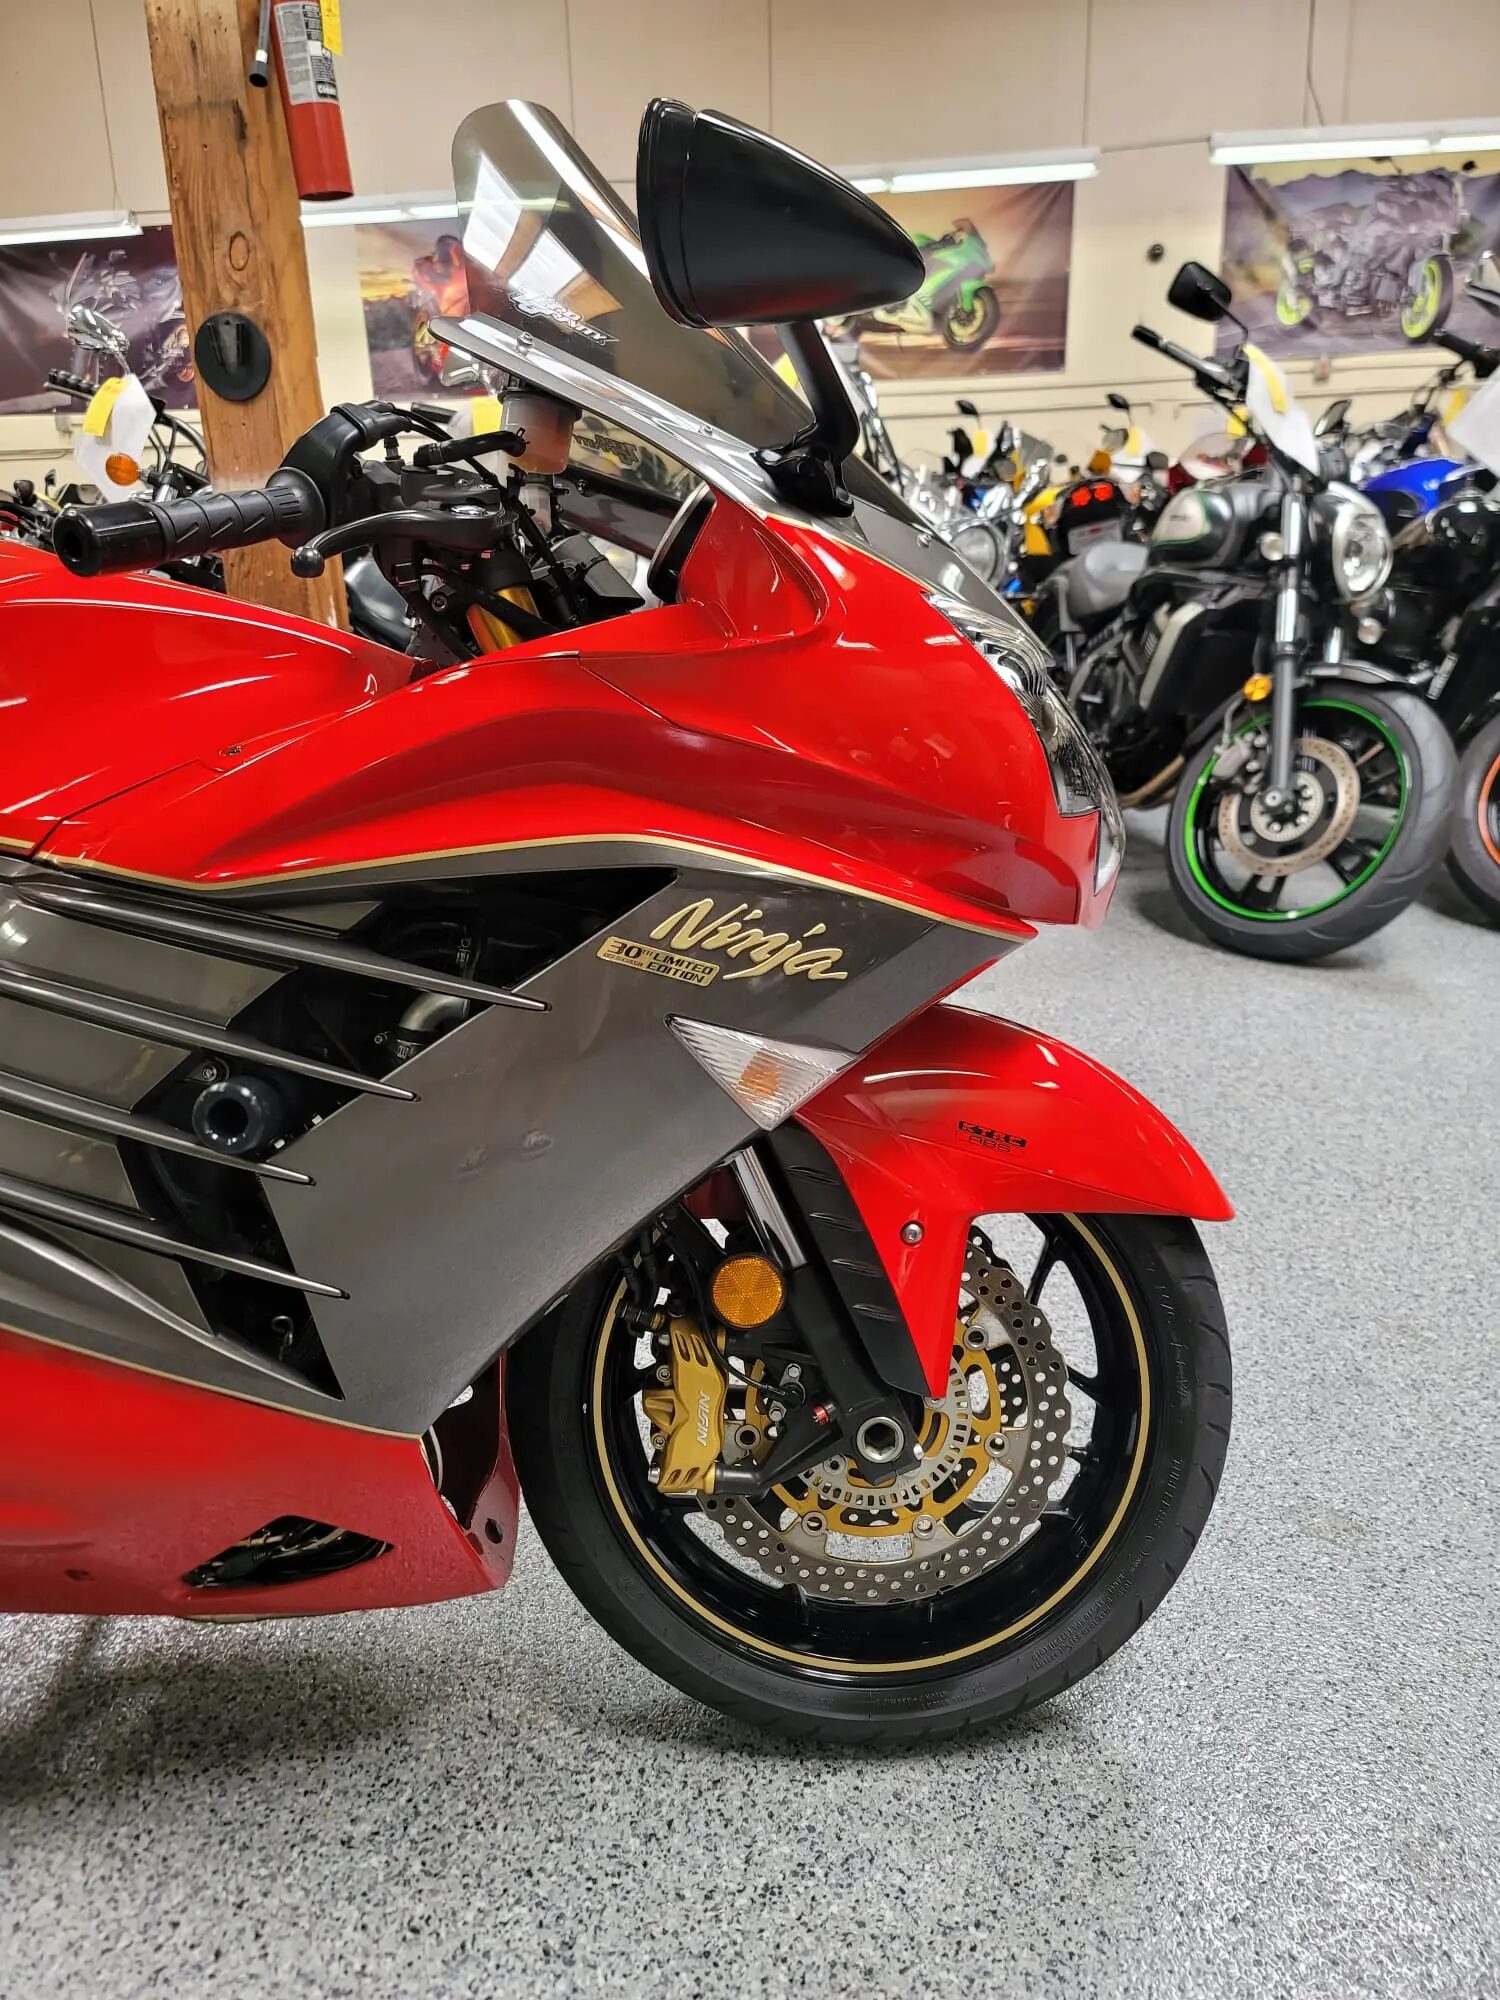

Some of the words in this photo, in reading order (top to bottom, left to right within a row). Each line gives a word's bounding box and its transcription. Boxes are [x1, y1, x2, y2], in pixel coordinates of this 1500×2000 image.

[650, 898, 848, 980] Ninja
[647, 961, 705, 983] EDITION
[653, 953, 713, 975] LIMITED
[969, 1135, 1011, 1153] ABS
